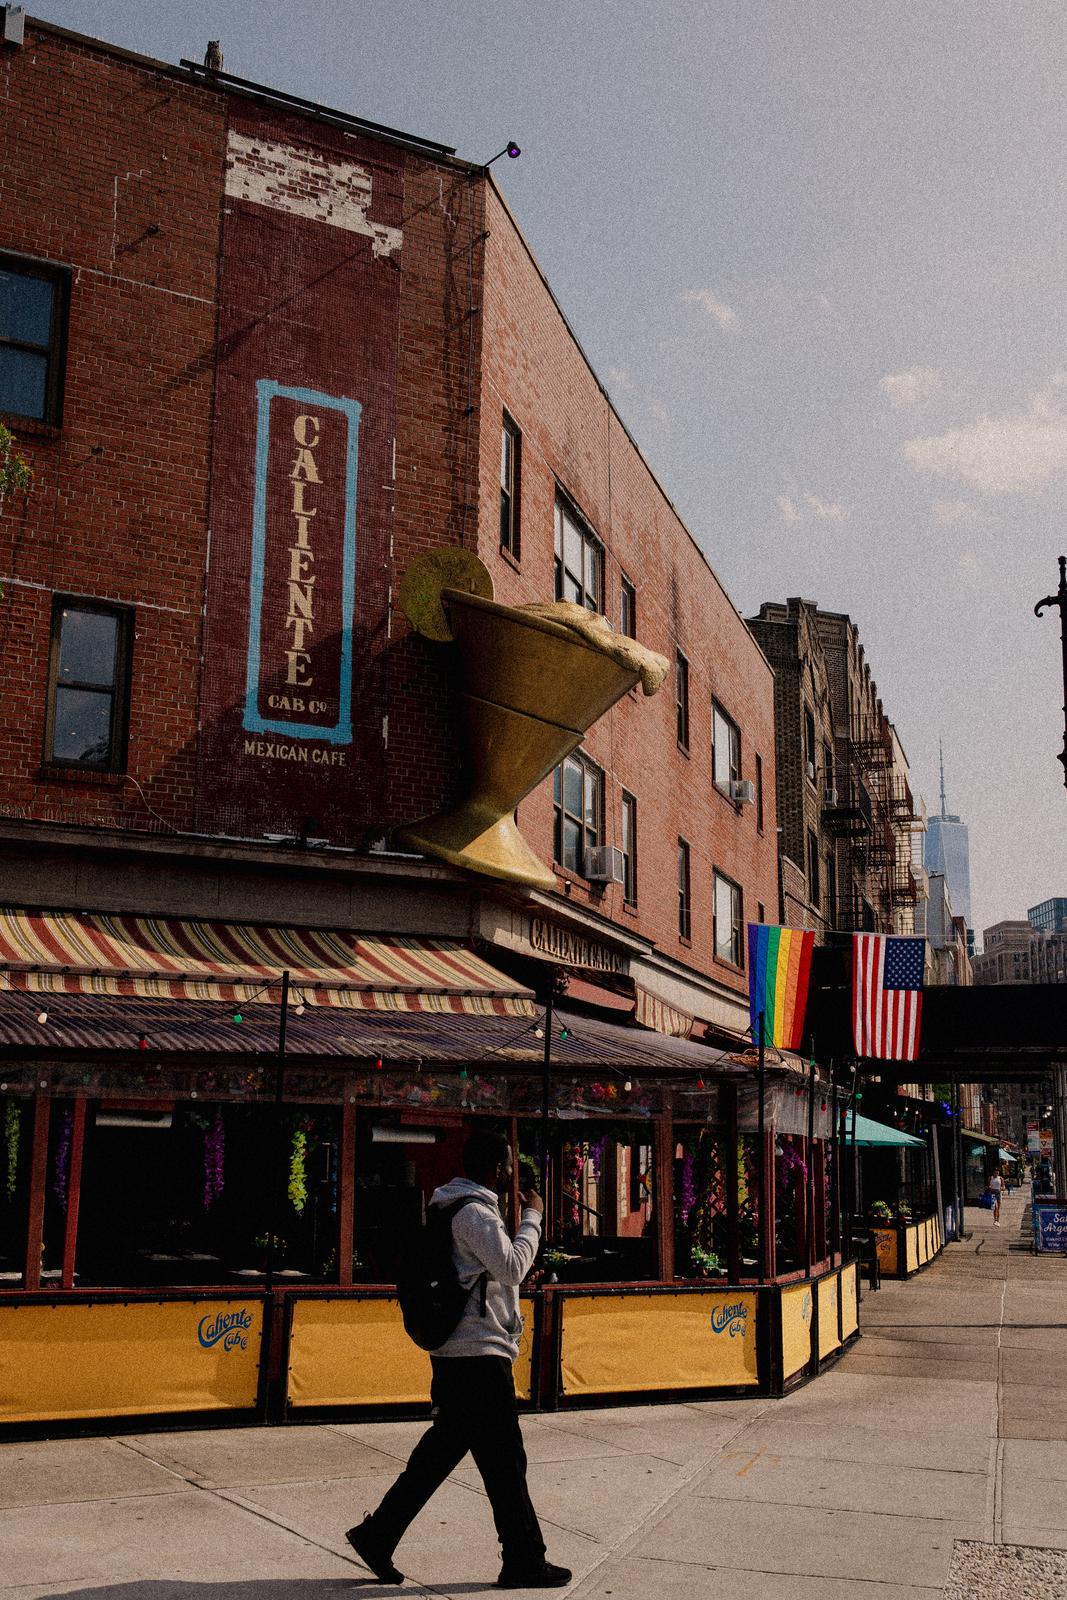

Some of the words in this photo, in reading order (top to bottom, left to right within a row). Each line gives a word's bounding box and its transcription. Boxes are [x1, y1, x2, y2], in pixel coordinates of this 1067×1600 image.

[285, 415, 323, 687] CALIENTE
[268, 694, 305, 712] CAB
[244, 740, 308, 762] MEXICAN
[312, 749, 347, 767] CAFE
[531, 918, 589, 967] CALIENTE
[198, 1308, 252, 1348] Caliente
[711, 1300, 748, 1333] Caliente
[224, 1331, 241, 1352] Cab
